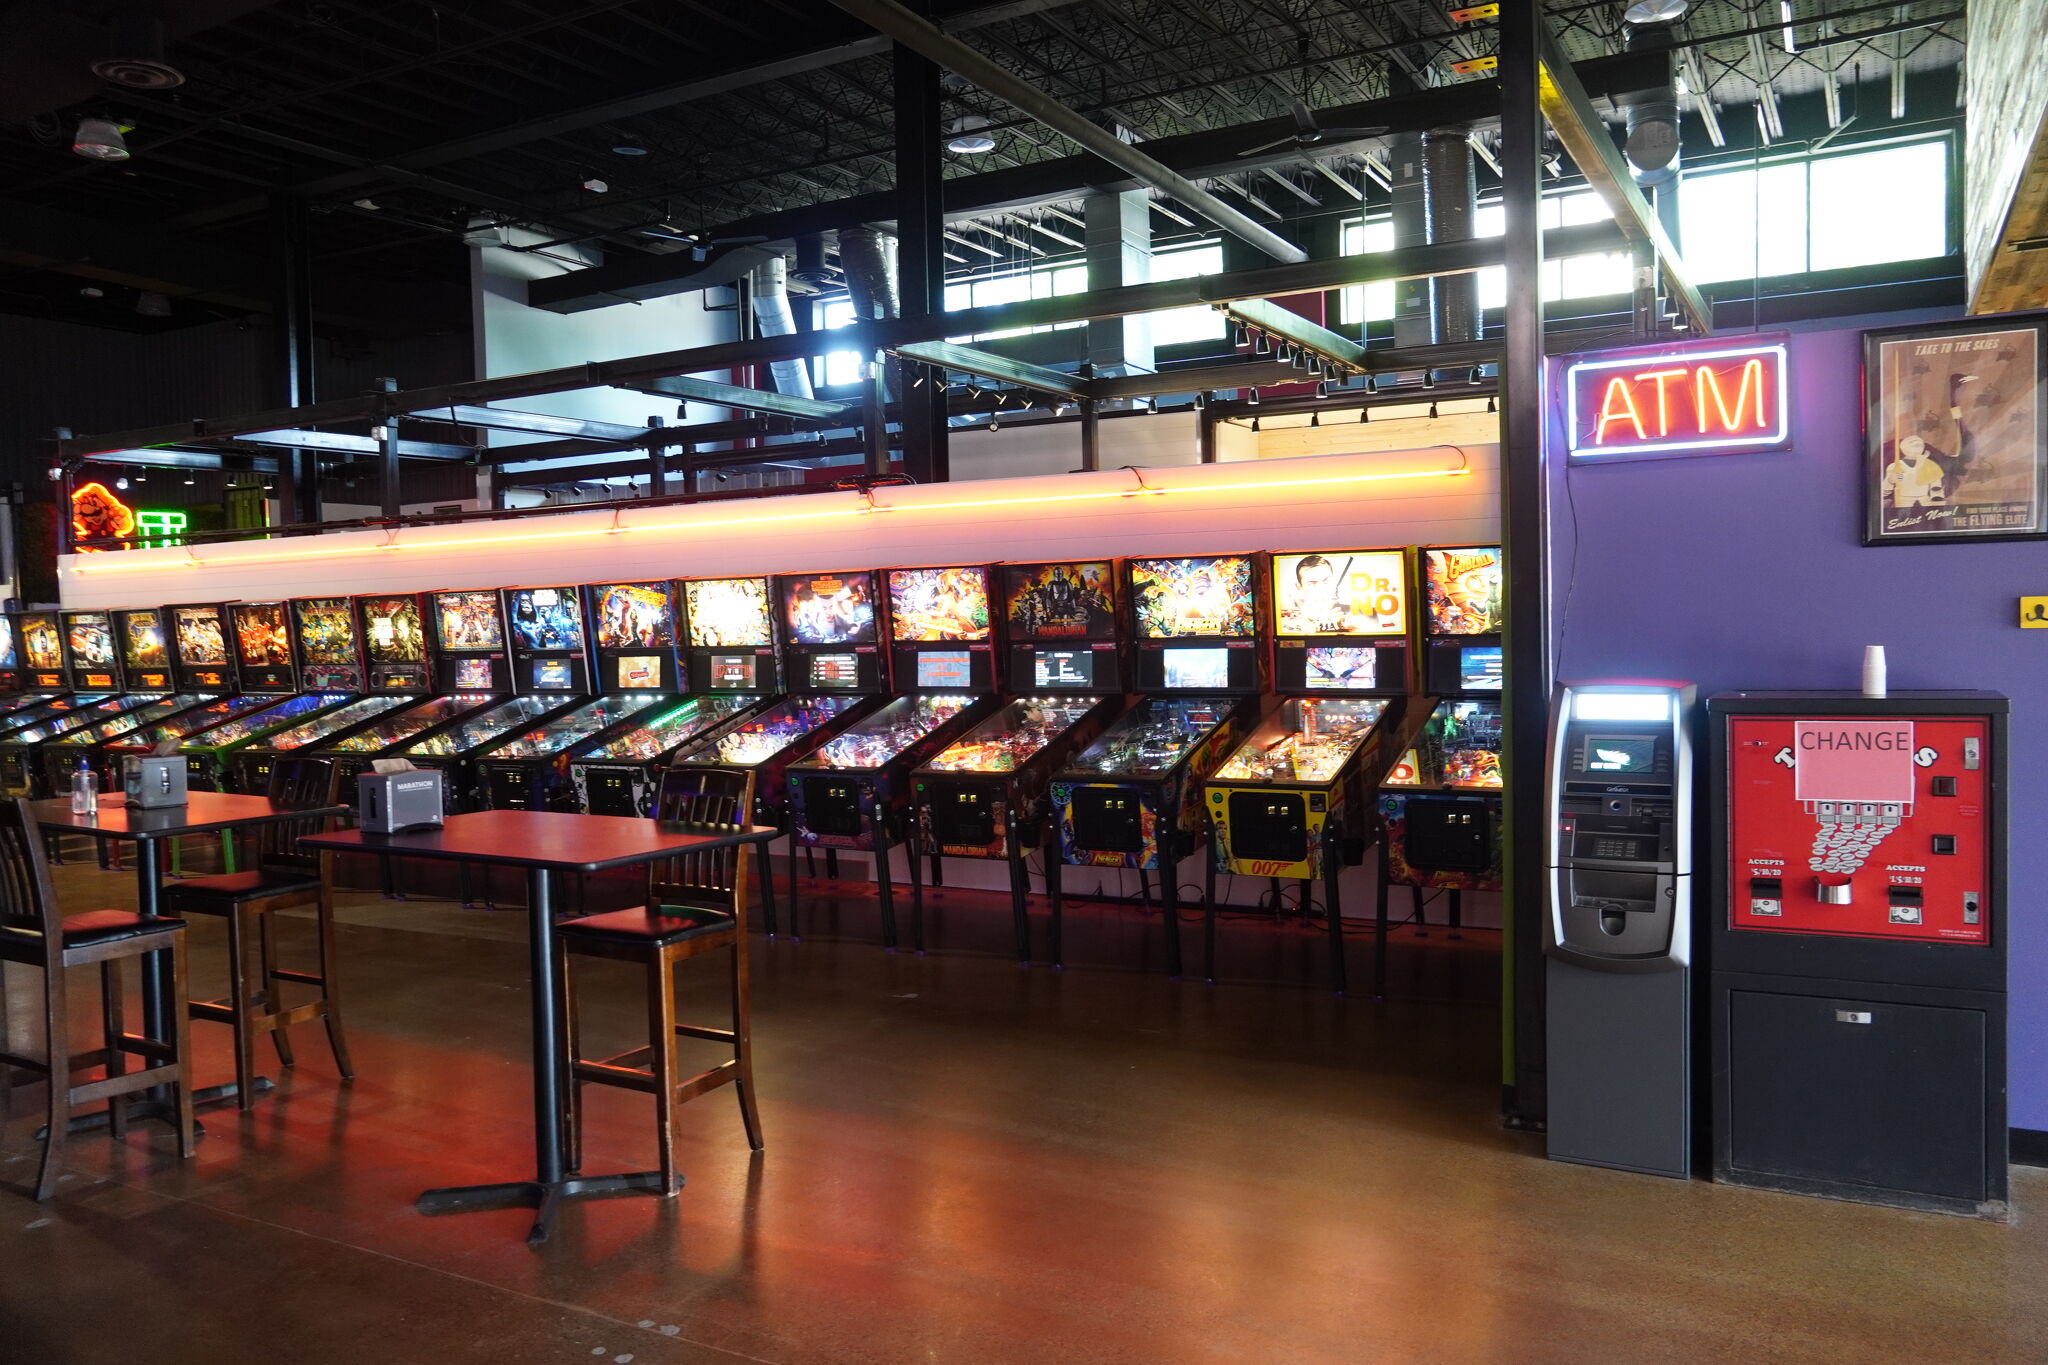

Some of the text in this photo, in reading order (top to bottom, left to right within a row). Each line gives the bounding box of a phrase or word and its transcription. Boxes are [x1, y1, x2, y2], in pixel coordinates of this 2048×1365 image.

[1914, 339, 2000, 356] TAKE TO THE SKIES
[1595, 359, 1766, 445] ATM
[1887, 506, 1959, 530] Enlist Now!
[1952, 514, 2027, 527] THE FLYING ELITE
[1351, 594, 1399, 616] NO
[1800, 731, 1909, 751] CHANGE
[397, 780, 433, 790] MARATHON
[1251, 860, 1290, 876] 007
[1748, 858, 1785, 866] ACCEPTS
[1885, 864, 1926, 872] ACCEPTS
